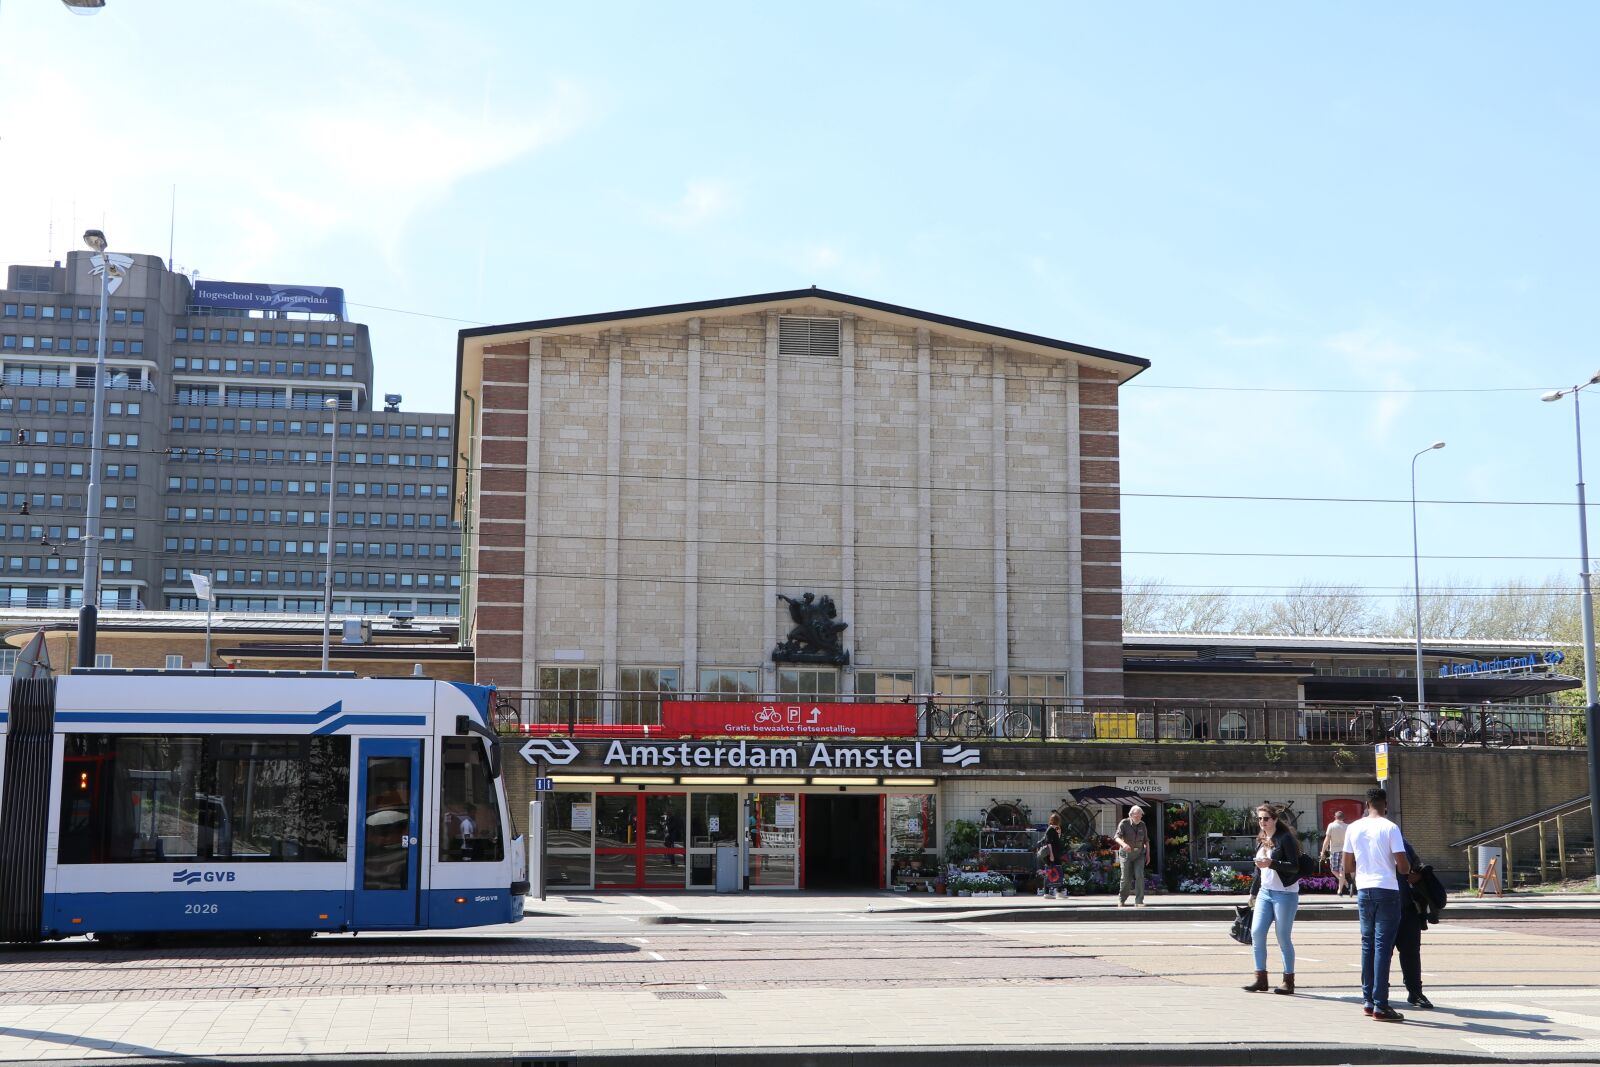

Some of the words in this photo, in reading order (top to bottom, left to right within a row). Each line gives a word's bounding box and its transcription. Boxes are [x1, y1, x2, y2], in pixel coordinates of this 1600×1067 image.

[199, 290, 252, 301] Hogeschool
[275, 294, 328, 304] Amsterdam
[724, 724, 751, 732] Gratis
[753, 724, 795, 733] bewaakte
[797, 724, 856, 734] fietsenstalling
[603, 740, 798, 767] Amsterdam
[809, 741, 922, 768] Amstel
[203, 871, 236, 882] GVB
[184, 903, 218, 914] 2026
